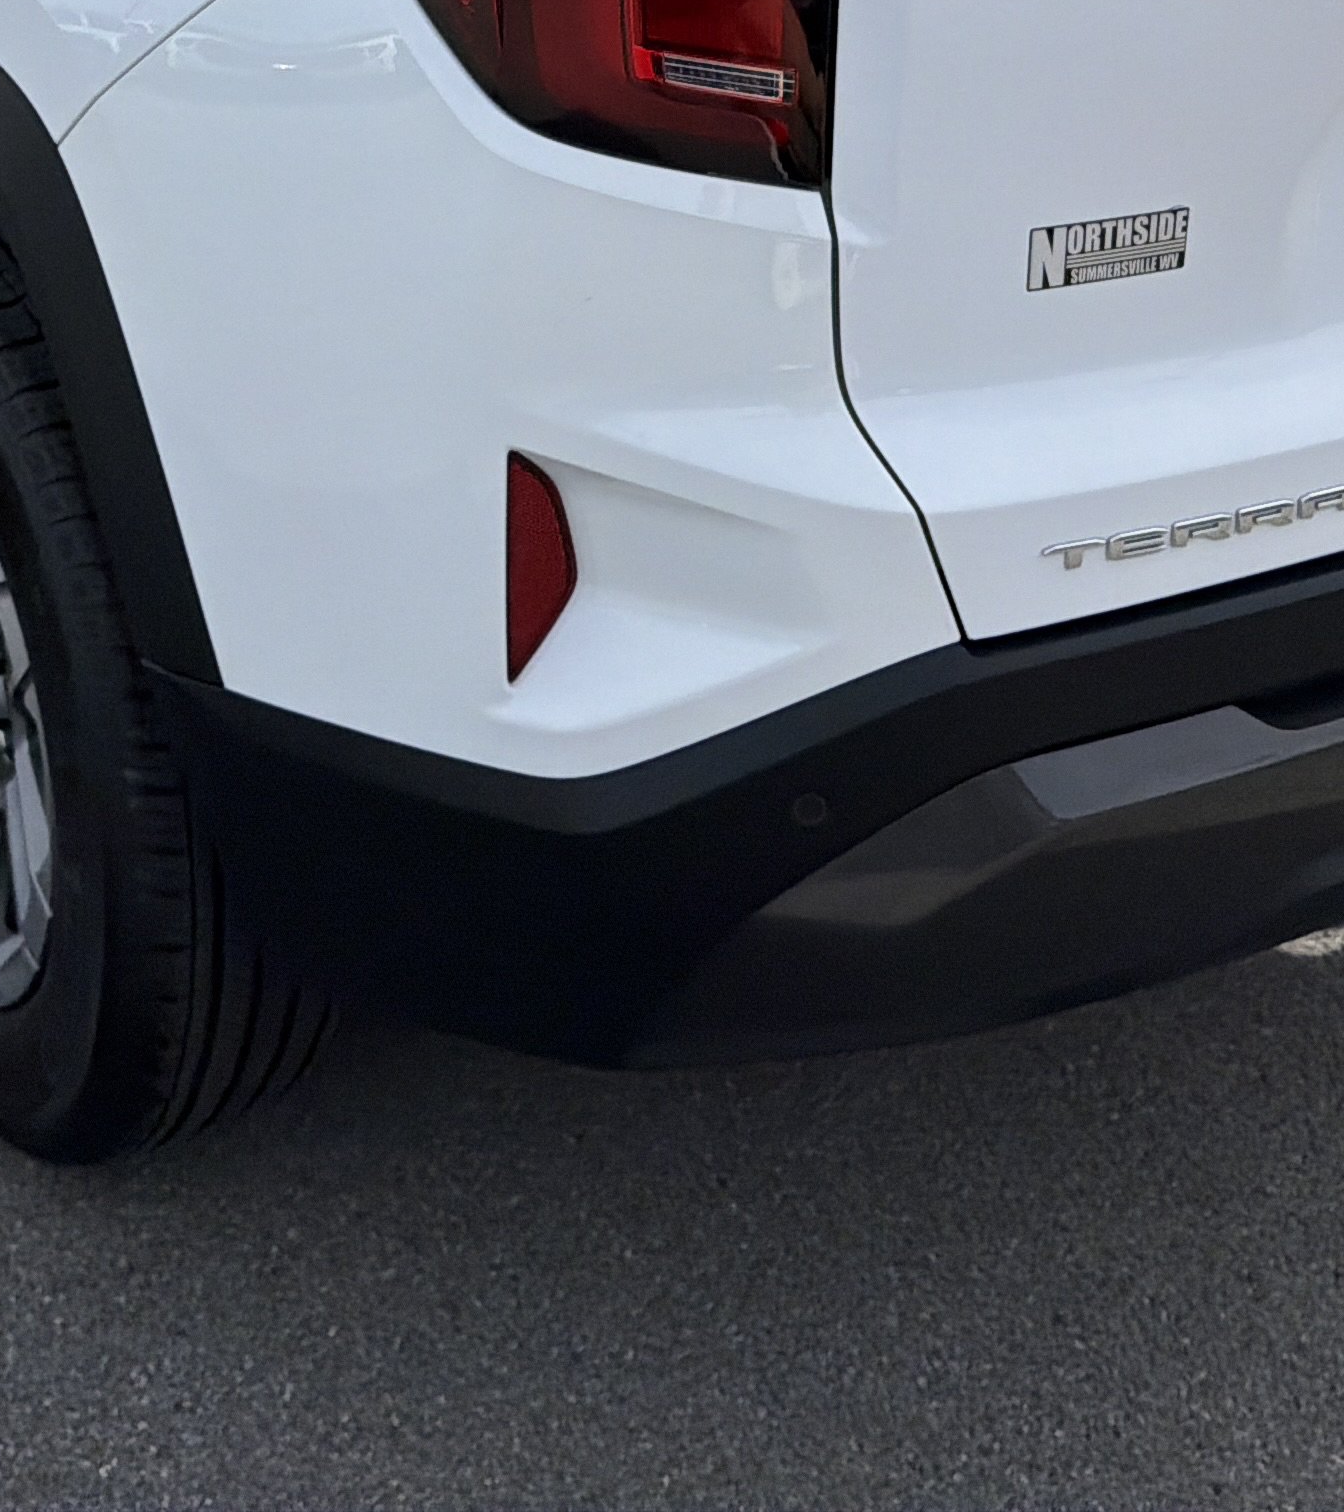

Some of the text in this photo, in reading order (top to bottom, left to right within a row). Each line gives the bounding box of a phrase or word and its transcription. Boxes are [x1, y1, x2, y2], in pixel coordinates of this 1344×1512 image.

[1029, 209, 1188, 290] NORTHSIDE
[1070, 252, 1179, 284] SUMMERSVILLE WV
